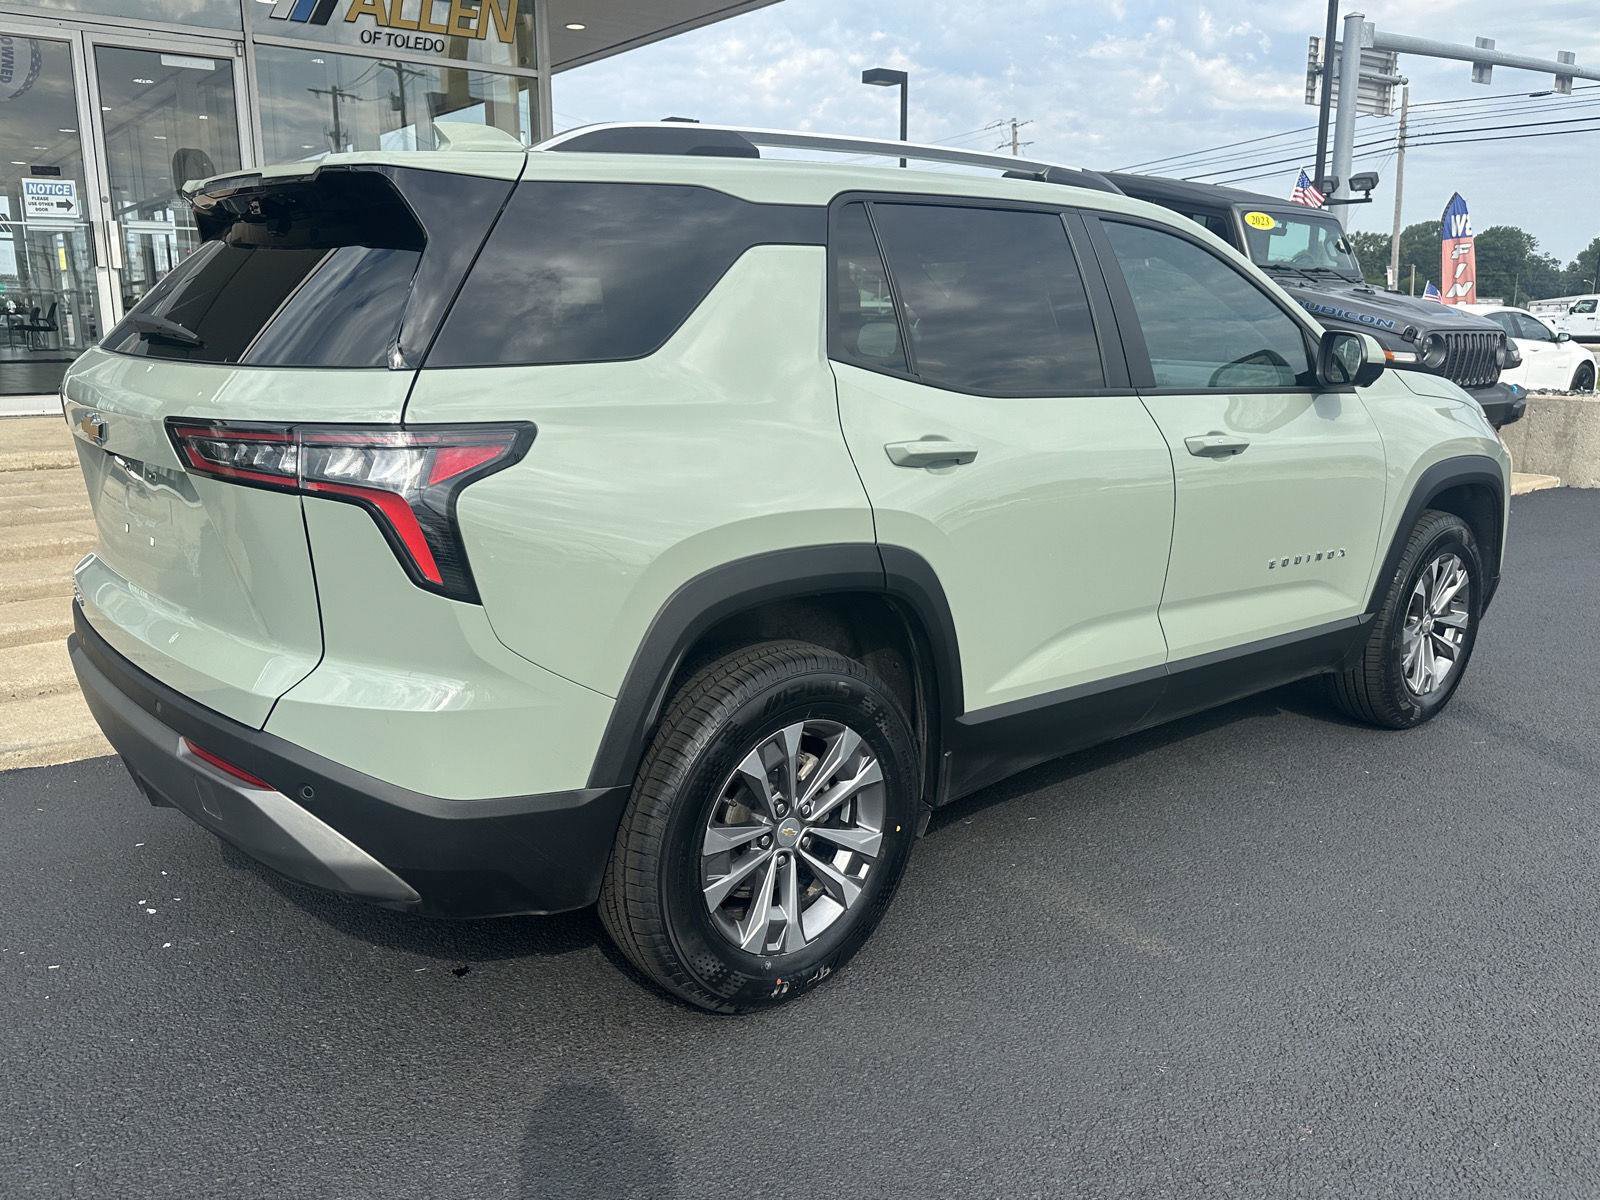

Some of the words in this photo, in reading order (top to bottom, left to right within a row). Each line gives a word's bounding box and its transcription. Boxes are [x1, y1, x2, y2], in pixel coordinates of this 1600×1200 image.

[344, 0, 518, 44] ALLEN
[360, 29, 383, 45] OF
[385, 33, 445, 53] TOLEDO
[0, 36, 14, 83] OWNED
[28, 183, 70, 195] NOTICE
[1251, 215, 1270, 226] 2023
[1445, 243, 1474, 304] FIN
[1298, 300, 1396, 329] UBICON
